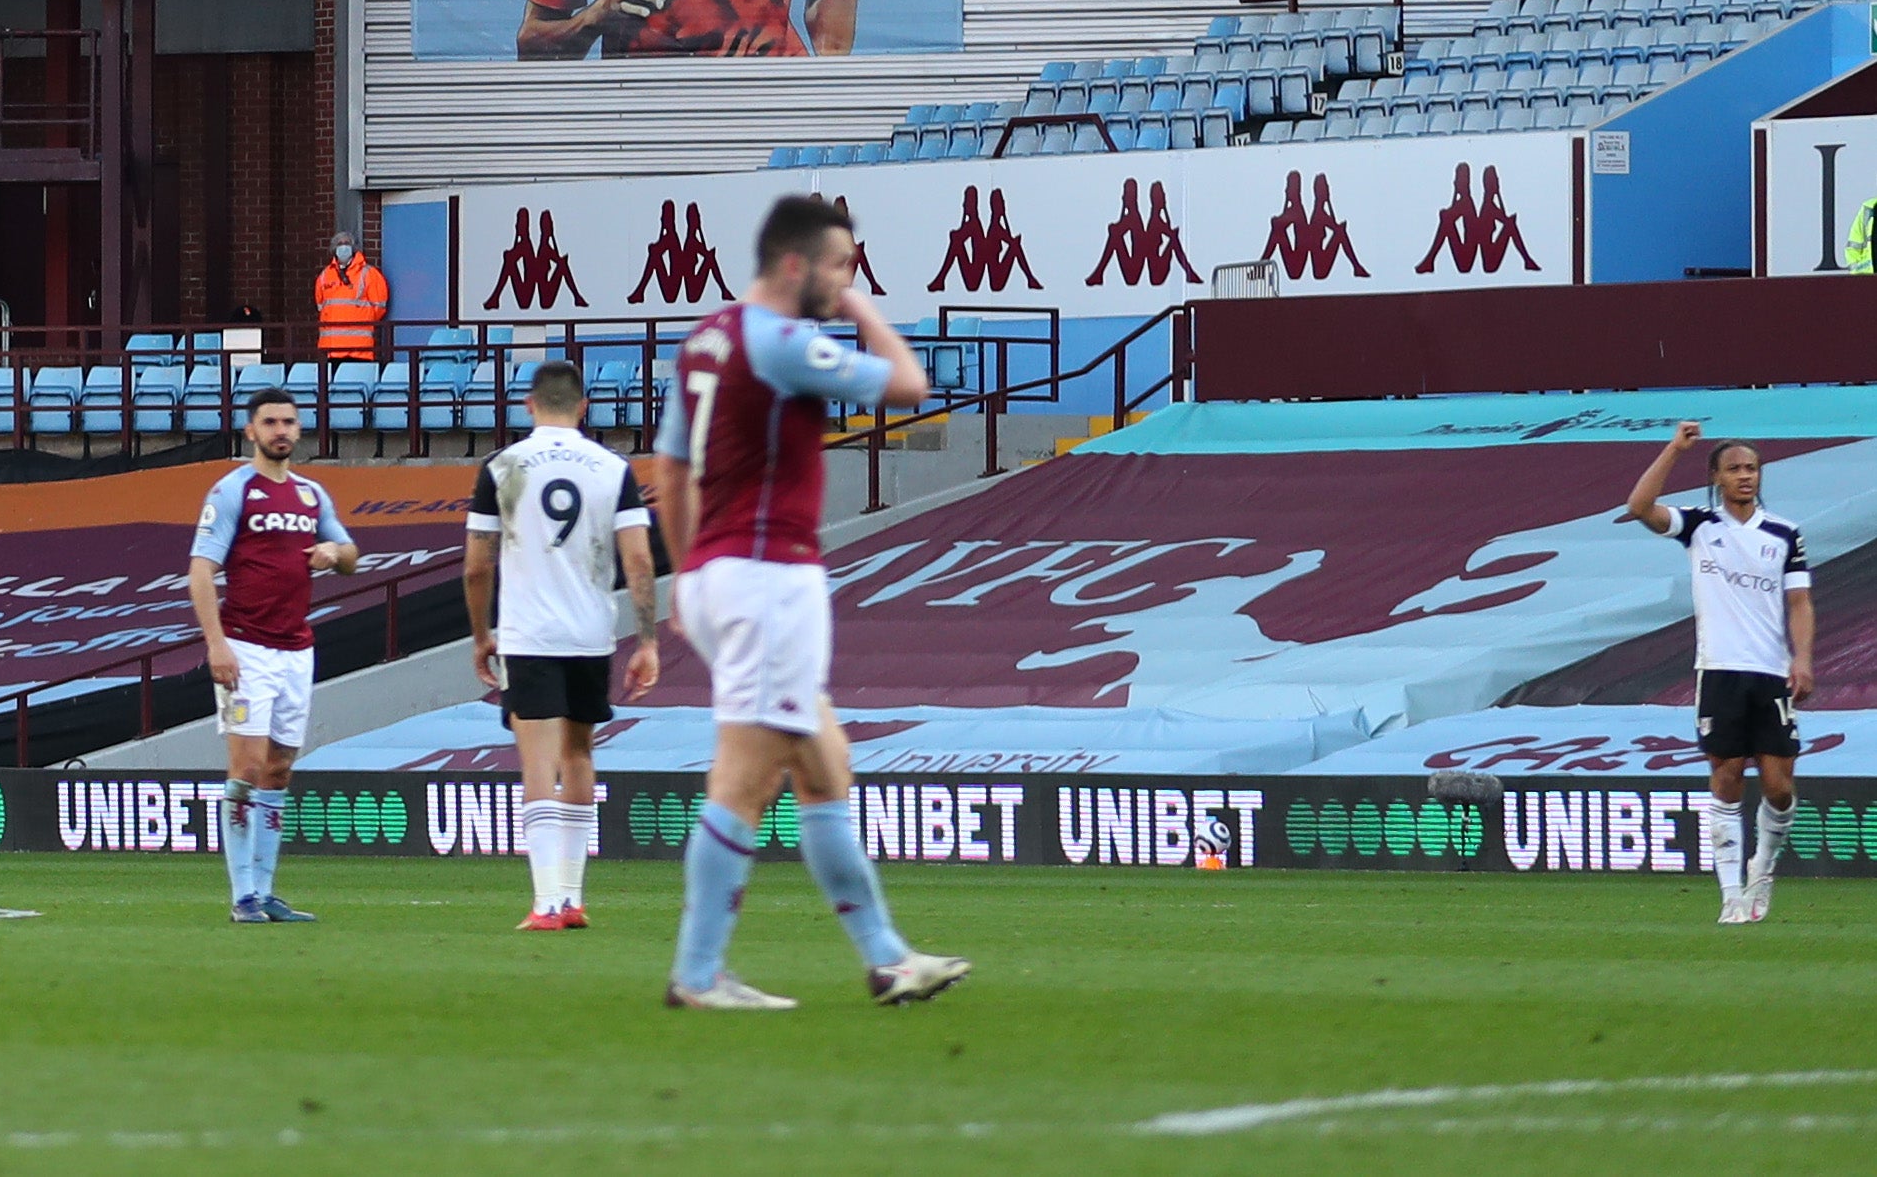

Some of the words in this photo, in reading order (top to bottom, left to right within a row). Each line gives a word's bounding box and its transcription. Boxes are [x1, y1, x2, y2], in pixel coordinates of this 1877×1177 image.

[1389, 56, 1403, 71] 18
[1314, 95, 1326, 109] 17
[410, 497, 475, 513] AR
[540, 477, 583, 548] 9
[849, 785, 1024, 859] NIBET
